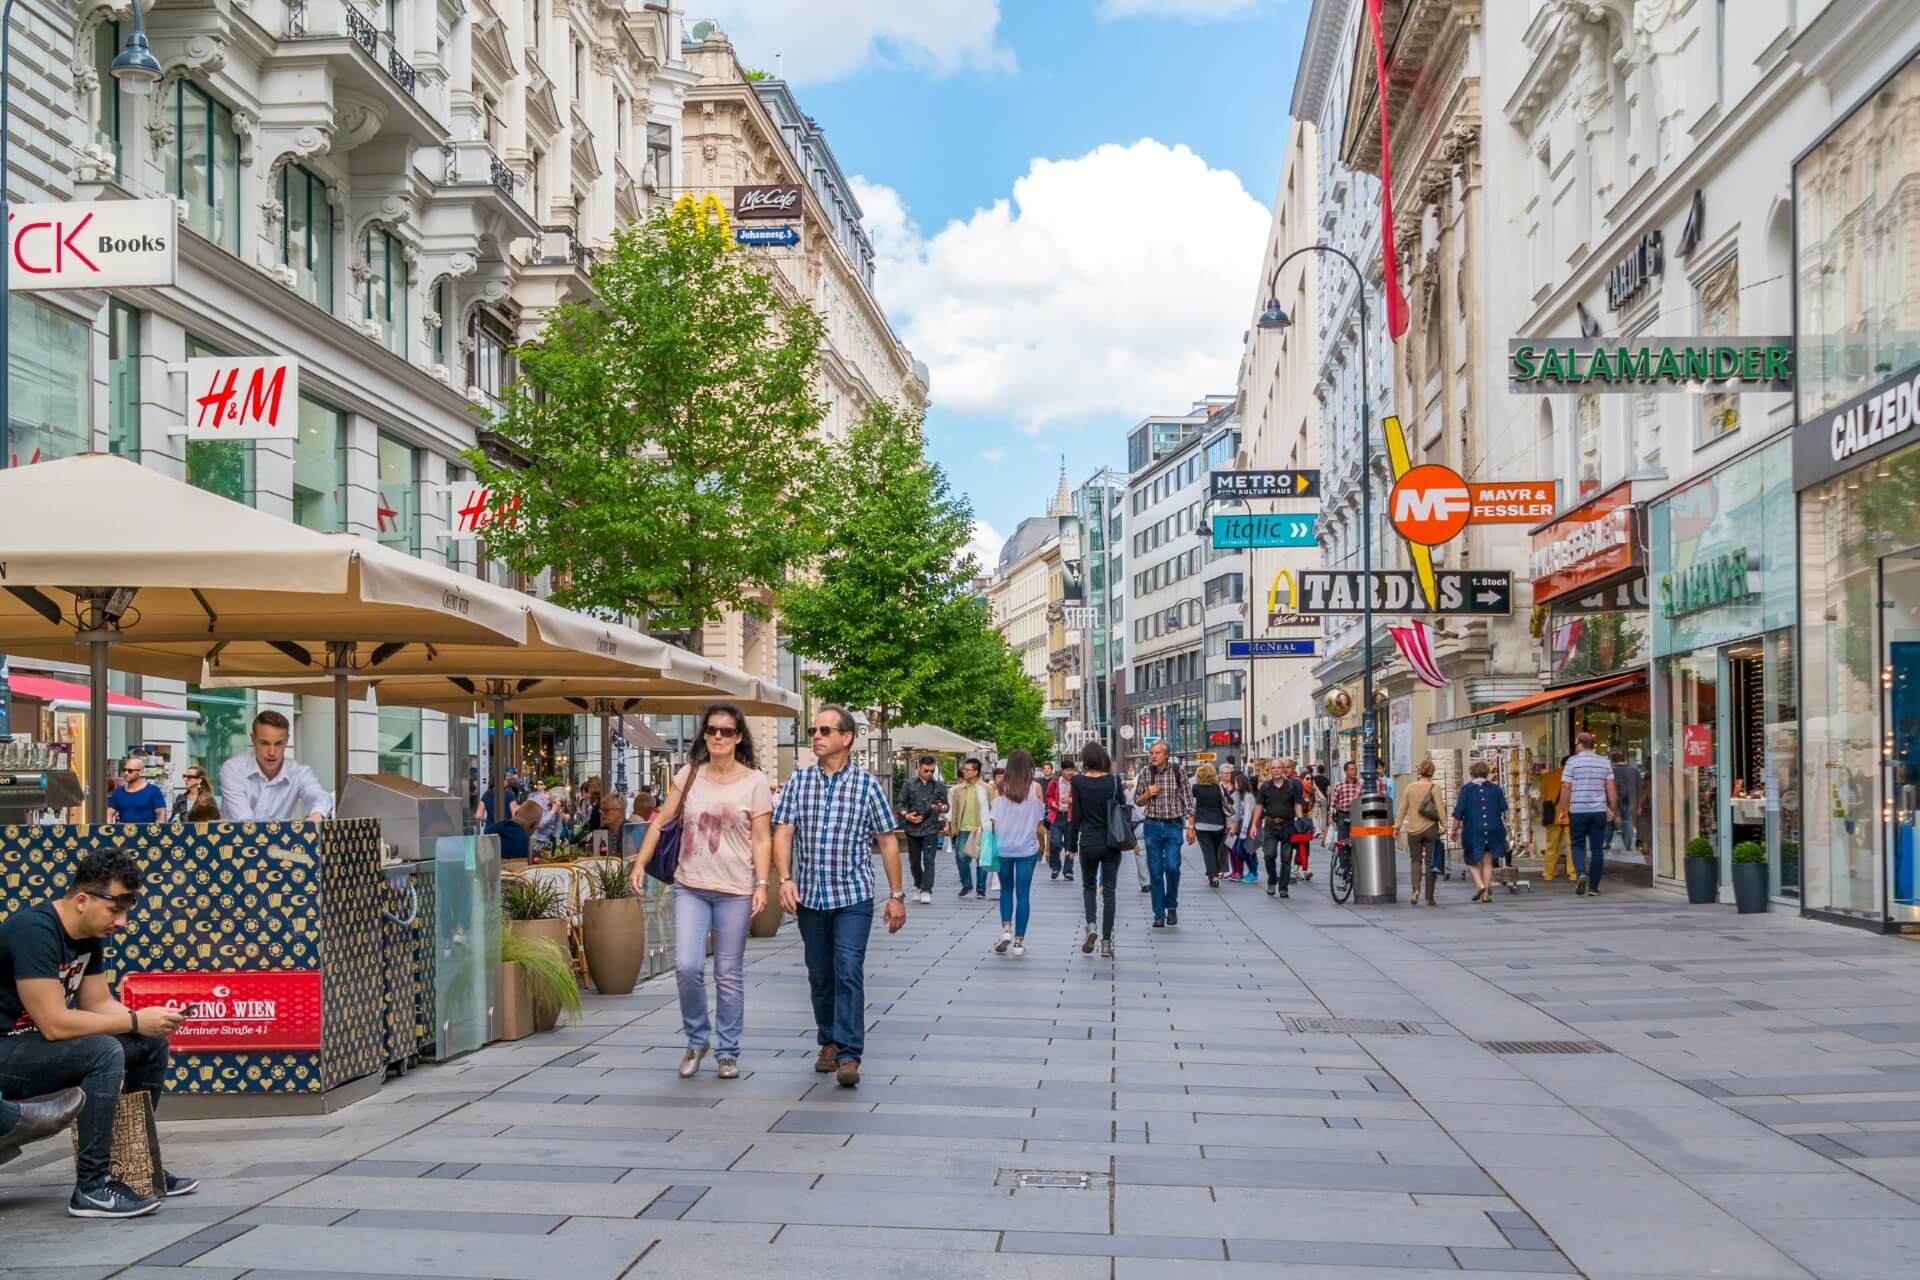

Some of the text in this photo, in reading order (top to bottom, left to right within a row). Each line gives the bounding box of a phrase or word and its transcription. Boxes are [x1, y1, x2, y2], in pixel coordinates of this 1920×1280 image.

[98, 235, 165, 253] Books
[1514, 345, 1790, 382] SALAMANDER
[196, 366, 286, 429] H&M
[1217, 474, 1291, 489] METRO
[1480, 489, 1546, 502] MAYR &
[1395, 487, 1471, 522] MF
[1473, 504, 1553, 518] FESSLER
[1225, 519, 1282, 539] italic
[1482, 578, 1508, 586] Stock
[233, 1001, 276, 1018] WIEN
[220, 1025, 252, 1036] Straße
[255, 1025, 268, 1034] 41
